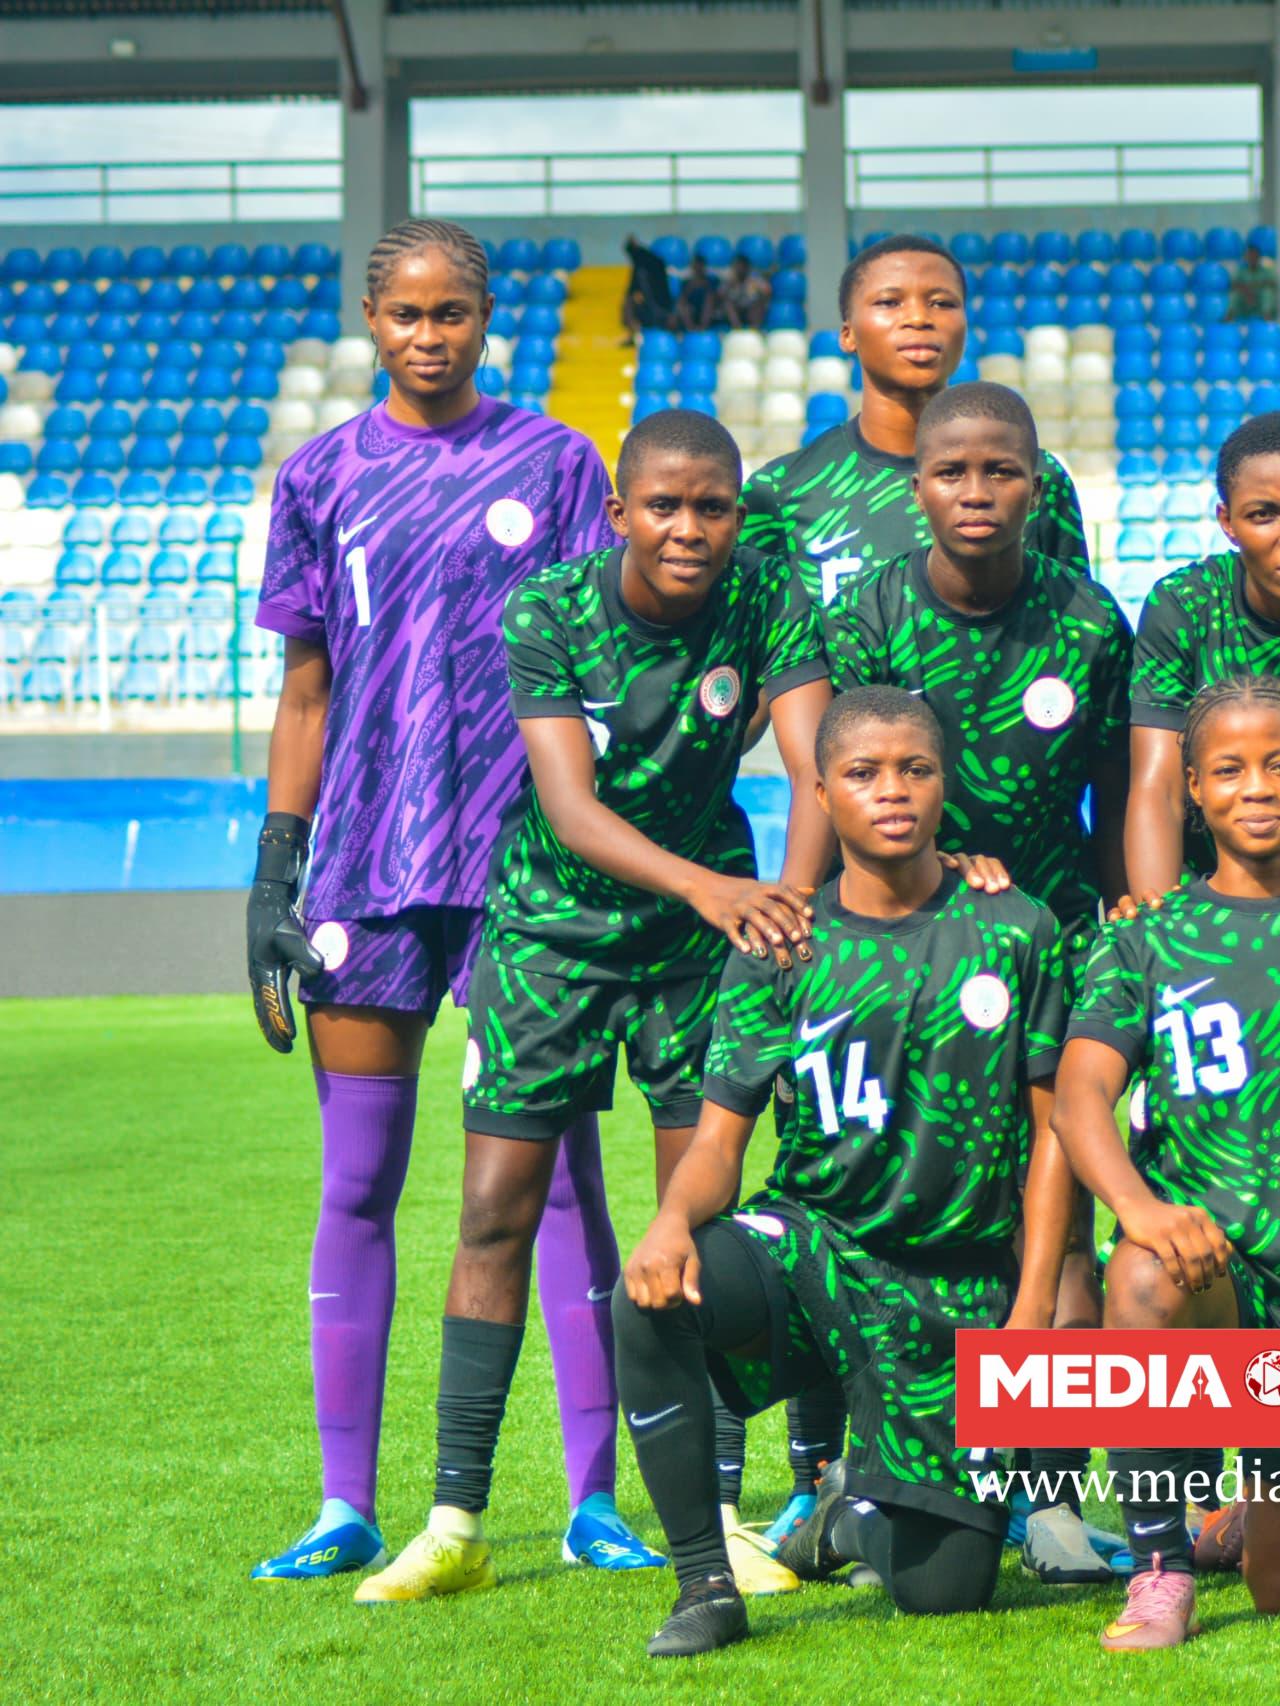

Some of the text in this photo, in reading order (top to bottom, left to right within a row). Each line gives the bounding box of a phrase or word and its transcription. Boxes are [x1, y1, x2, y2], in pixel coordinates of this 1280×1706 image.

[345, 546, 371, 627] 1
[794, 1040, 888, 1135] 14
[1153, 1001, 1248, 1096] 13
